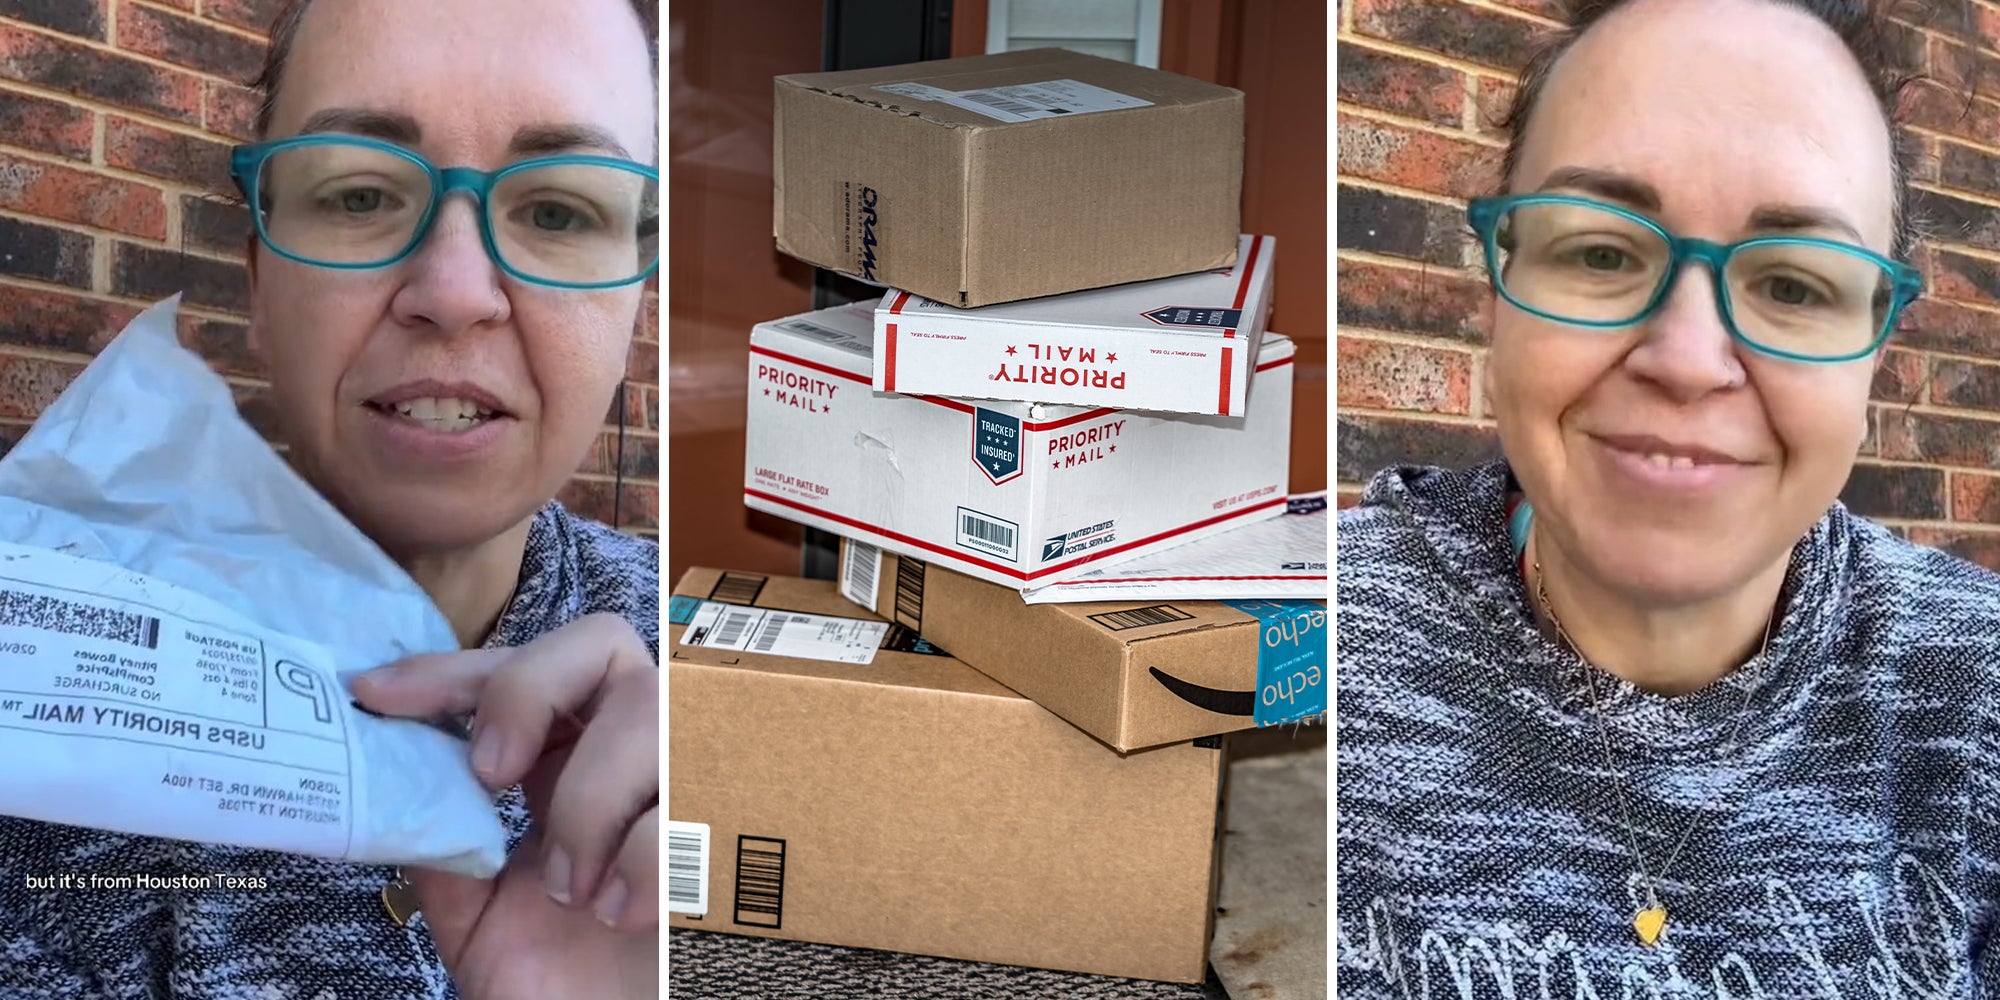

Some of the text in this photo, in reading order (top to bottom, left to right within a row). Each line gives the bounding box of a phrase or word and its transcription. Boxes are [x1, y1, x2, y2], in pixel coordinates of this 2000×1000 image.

[1028, 343, 1096, 364] MAIL
[776, 389, 817, 413] MAIL
[1065, 447, 1104, 469] MAIL
[755, 466, 830, 497] LARGE FLAT RATE BOX
[1067, 519, 1115, 541] UNITED STATES
[1064, 541, 1088, 556] POSTAL
[1265, 611, 1327, 647] echo
[1262, 665, 1322, 707] echo
